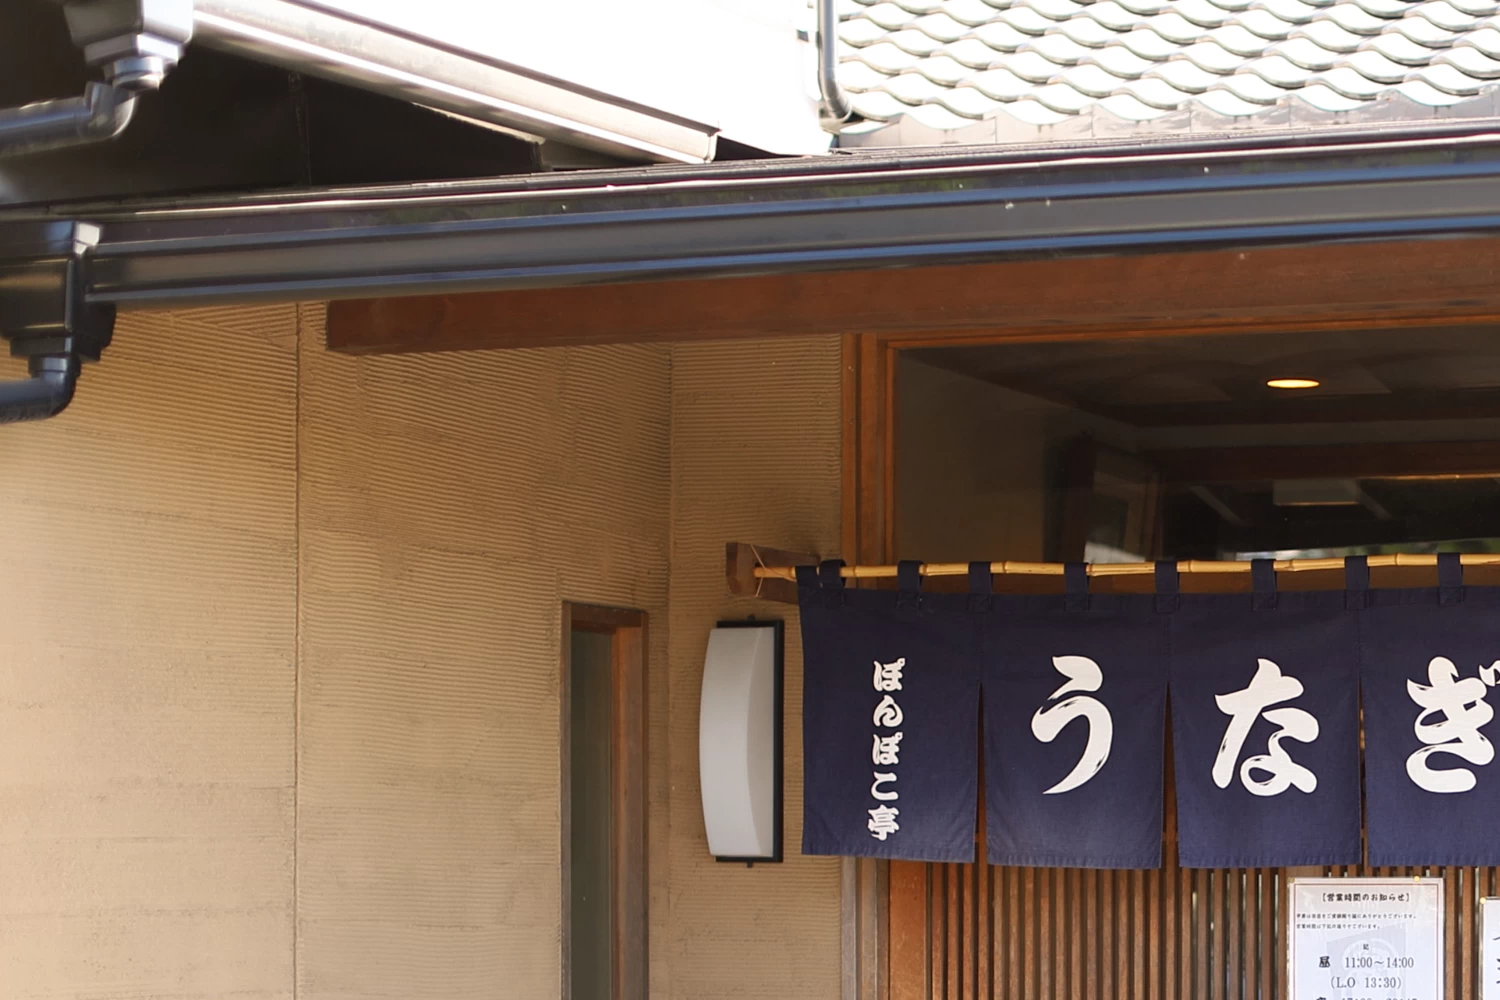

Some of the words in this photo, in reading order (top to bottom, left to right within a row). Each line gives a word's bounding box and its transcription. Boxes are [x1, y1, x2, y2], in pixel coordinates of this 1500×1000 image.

[867, 657, 906, 841] ぽんぽこ亭
[1318, 955, 1331, 968] 昼
